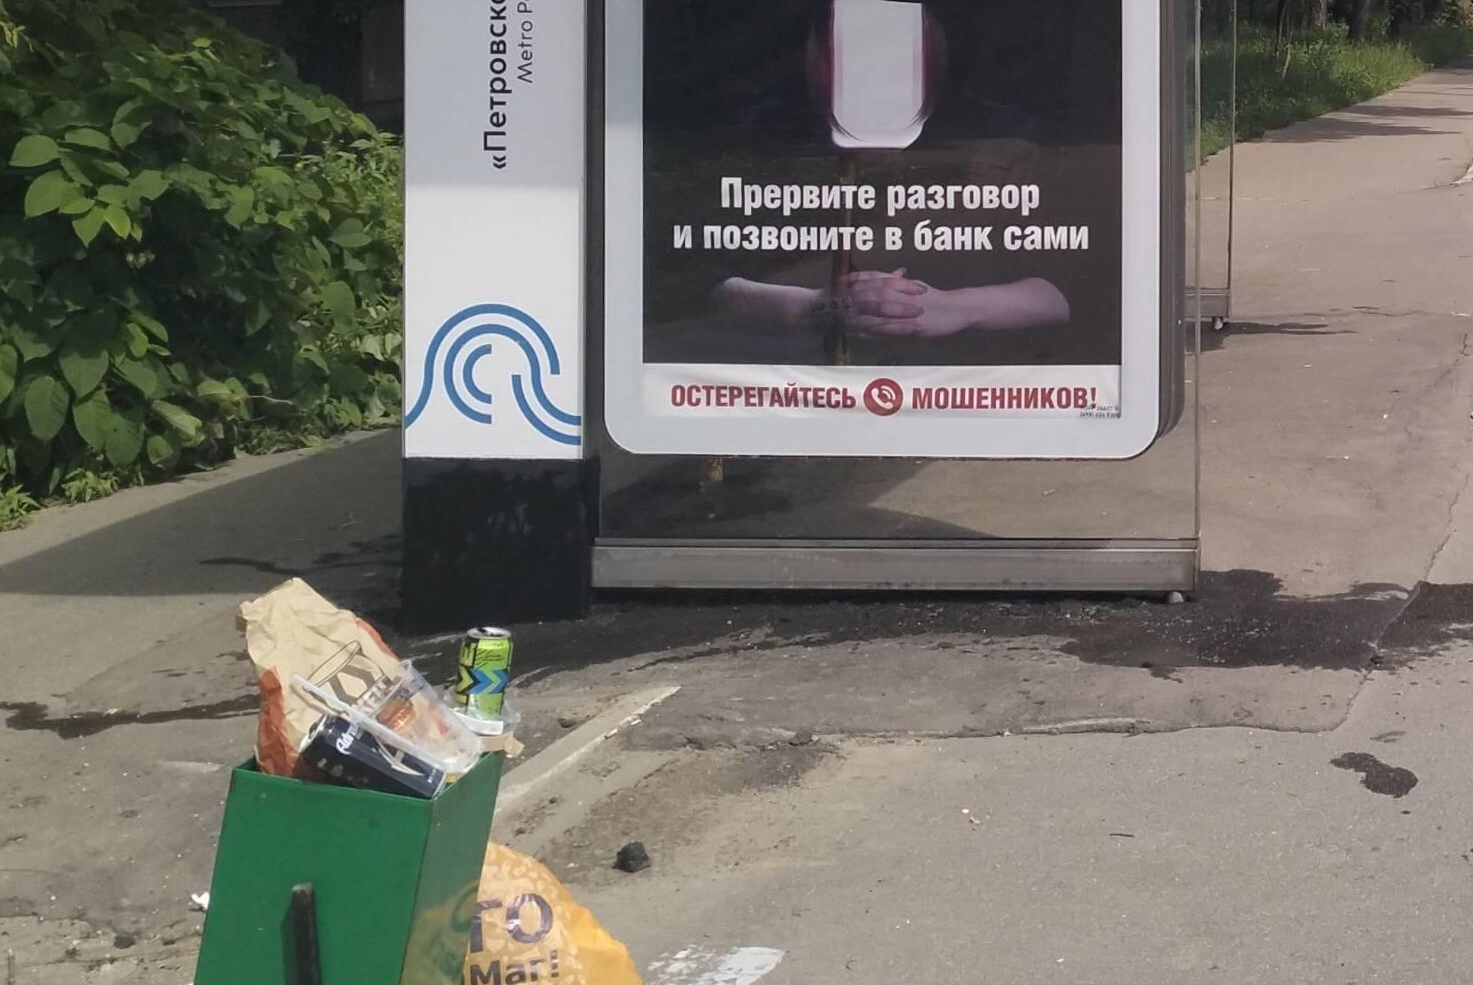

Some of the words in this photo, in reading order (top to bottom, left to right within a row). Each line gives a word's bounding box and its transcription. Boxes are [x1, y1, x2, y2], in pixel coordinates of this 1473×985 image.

[516, 20, 533, 84] Metro
[721, 176, 876, 216] Прервите
[887, 184, 1040, 216] разговор
[673, 225, 693, 249] и
[703, 225, 874, 251] позвоните
[885, 227, 902, 250] в
[914, 219, 993, 251] банк
[1003, 225, 1089, 251] сами
[671, 382, 857, 409] ОСТЕРЕГАЙТЕСЬ
[912, 387, 1096, 410] МОШЕННИКОВ!
